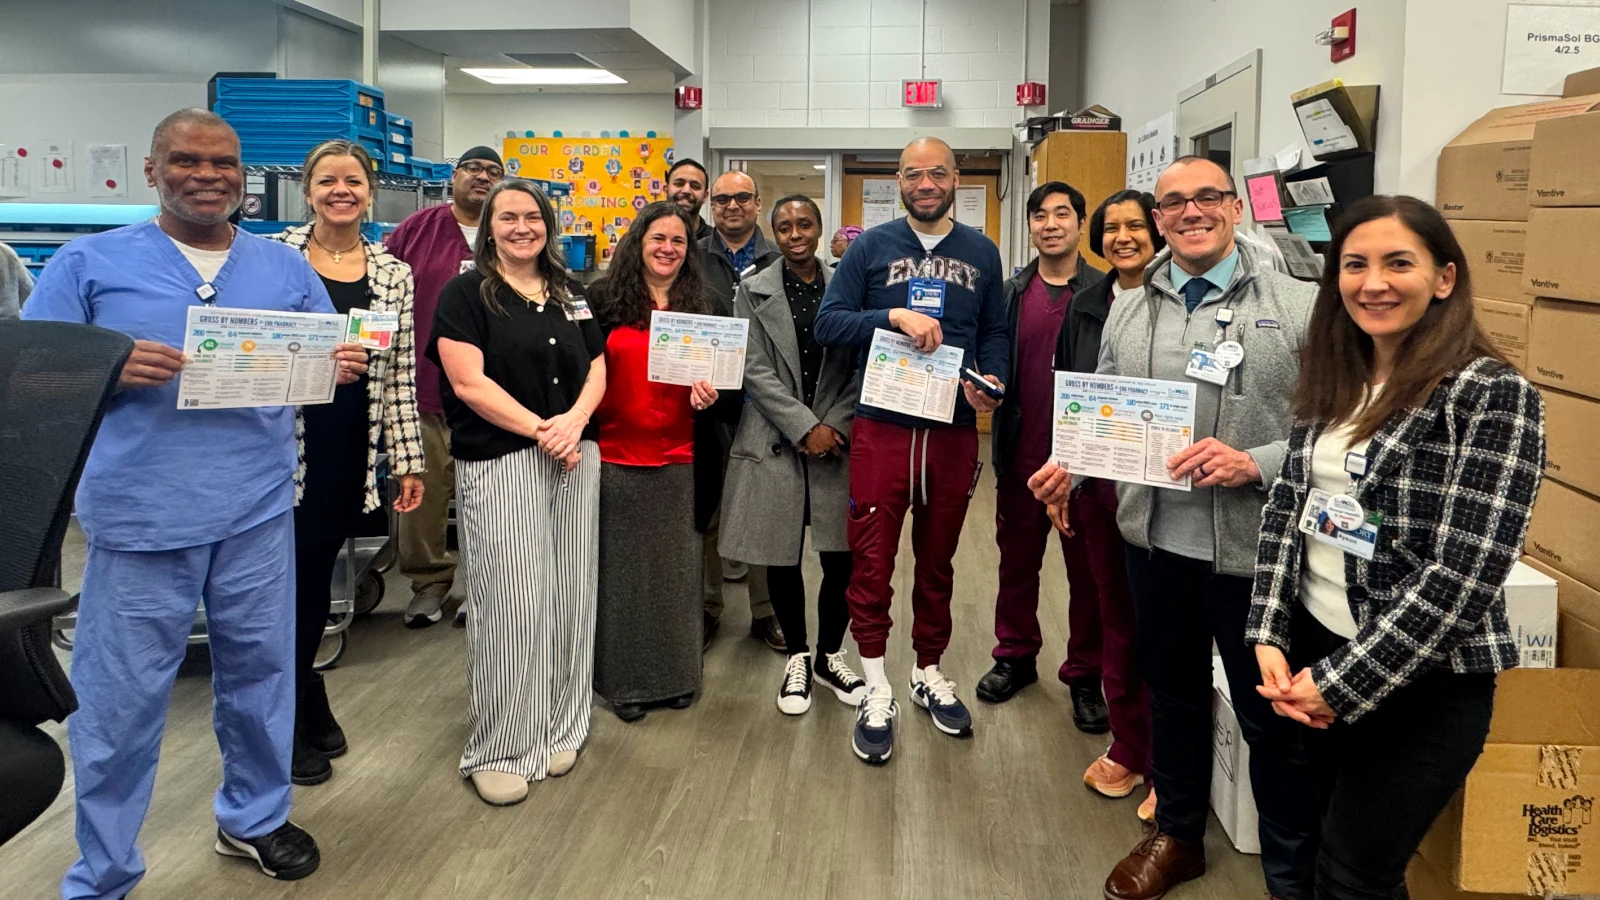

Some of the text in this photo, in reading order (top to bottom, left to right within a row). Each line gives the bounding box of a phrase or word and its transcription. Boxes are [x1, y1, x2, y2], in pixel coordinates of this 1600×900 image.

[1527, 32, 1580, 42] PrismaSol
[1554, 46, 1580, 54] 4/2.5
[906, 83, 937, 104] EXIT
[519, 144, 621, 156] OUR GARDEN
[550, 168, 565, 180] IS
[1537, 189, 1565, 197] Vantive
[885, 256, 980, 293] EMORY
[1531, 278, 1559, 289] Vantive
[230, 317, 258, 325] NUMBERS
[1536, 366, 1564, 380] Vantive
[1090, 382, 1114, 390] NUMBERS
[1533, 542, 1562, 562] Vantive
[1522, 804, 1562, 817] Health
[1531, 816, 1558, 826] Care
[1528, 824, 1578, 837] Logistics
